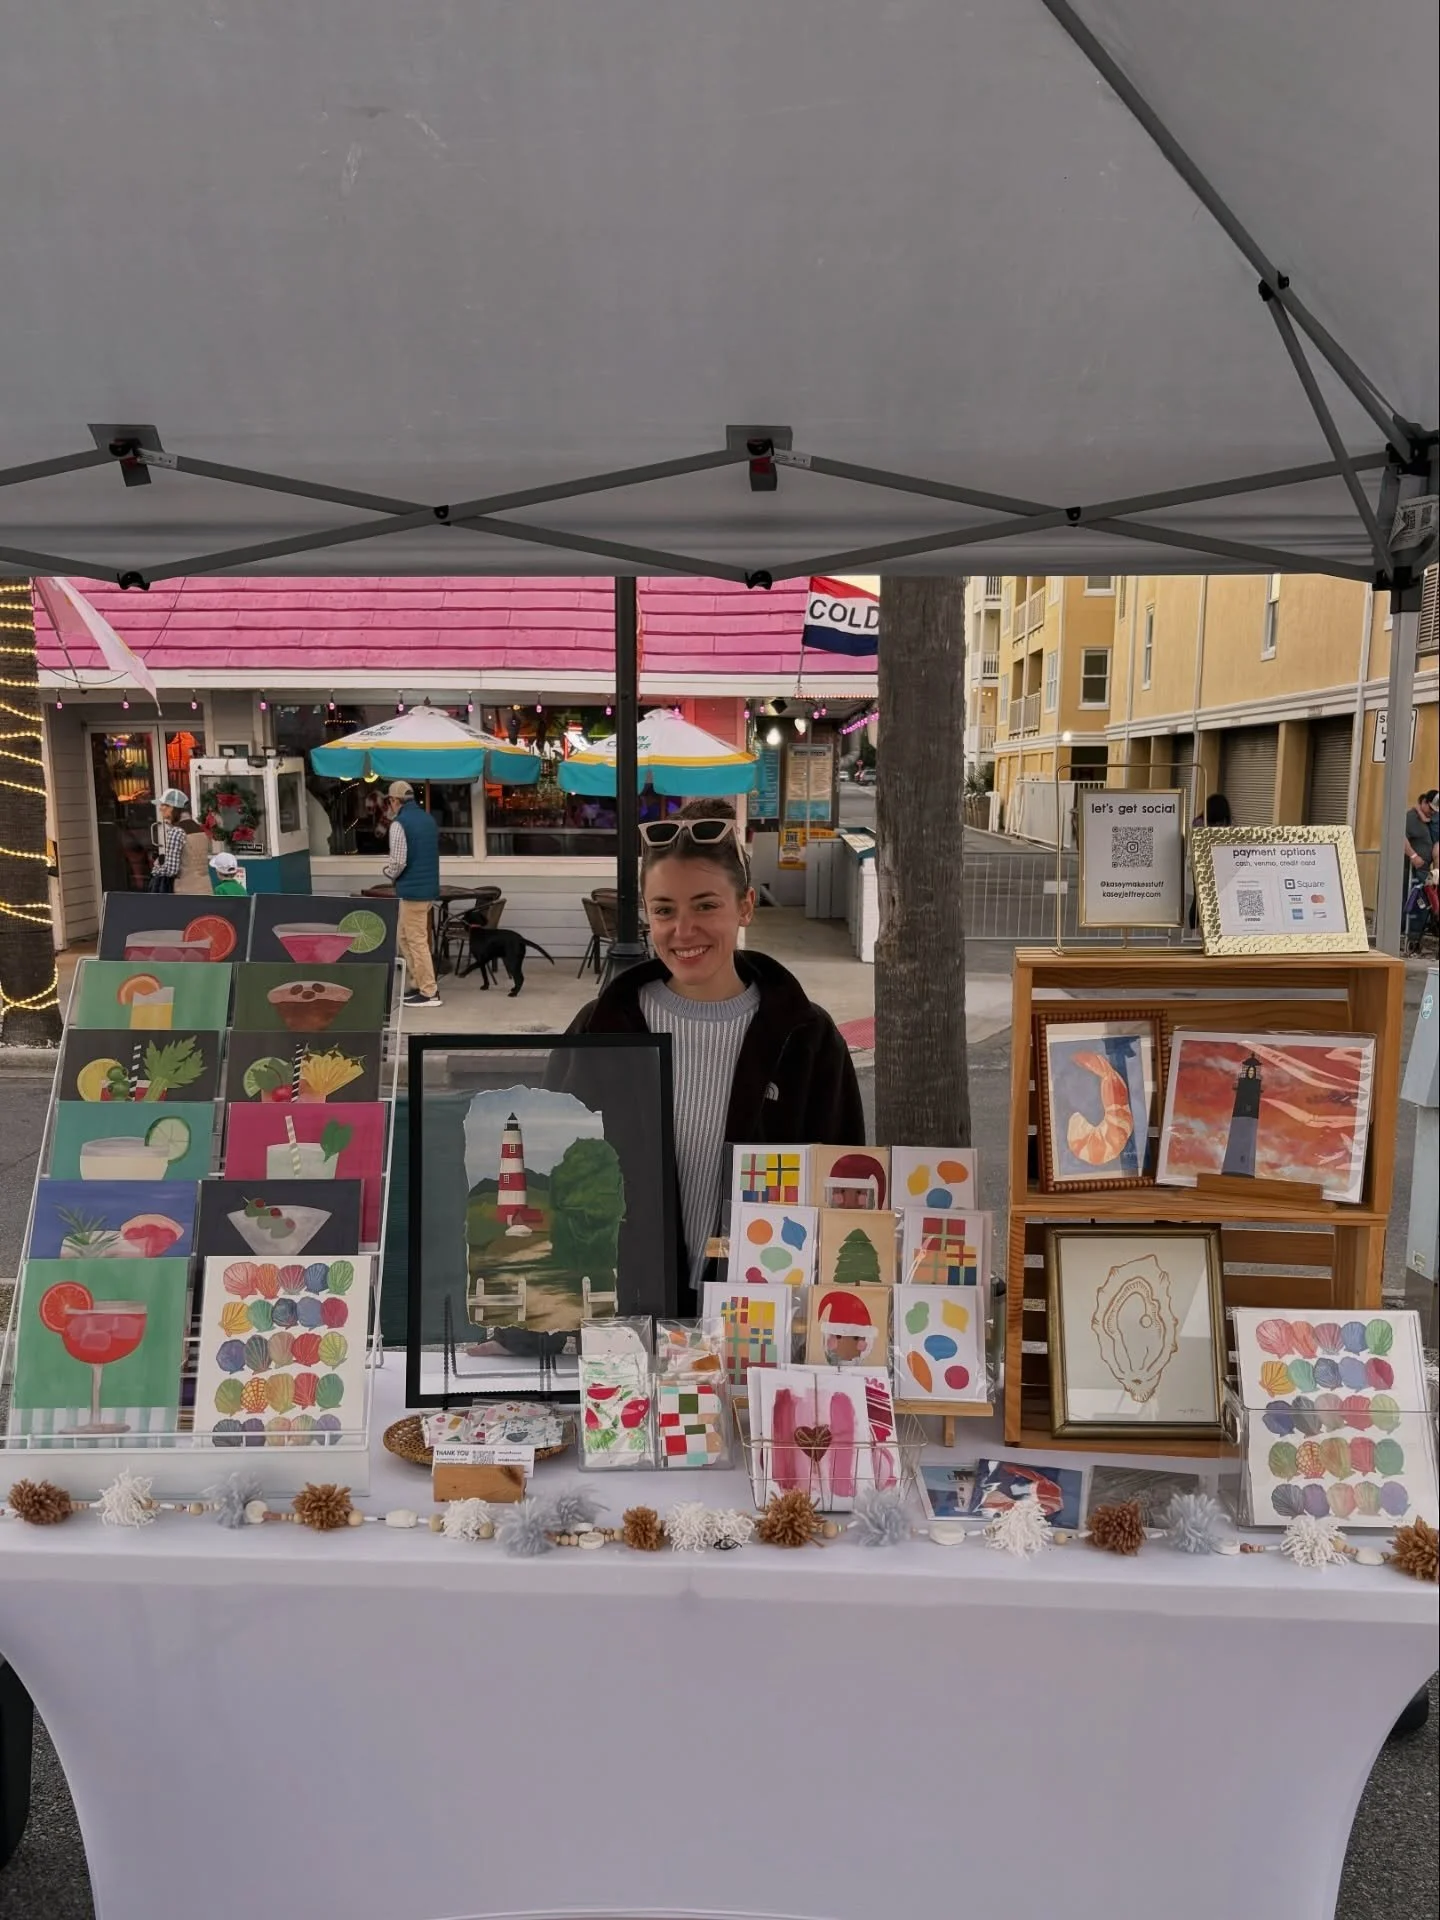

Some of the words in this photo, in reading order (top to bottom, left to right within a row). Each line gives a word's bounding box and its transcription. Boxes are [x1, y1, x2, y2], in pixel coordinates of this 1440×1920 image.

[809, 599, 880, 629] COLD
[1091, 803, 1114, 814] let's
[1118, 804, 1138, 815] get
[1142, 803, 1175, 814] social
[1232, 848, 1277, 859] payment
[1280, 848, 1317, 858] options
[1100, 881, 1164, 889] @kaseymakesstuff
[1297, 880, 1325, 889] Square
[1102, 890, 1161, 899] kaseyjeffrey.com
